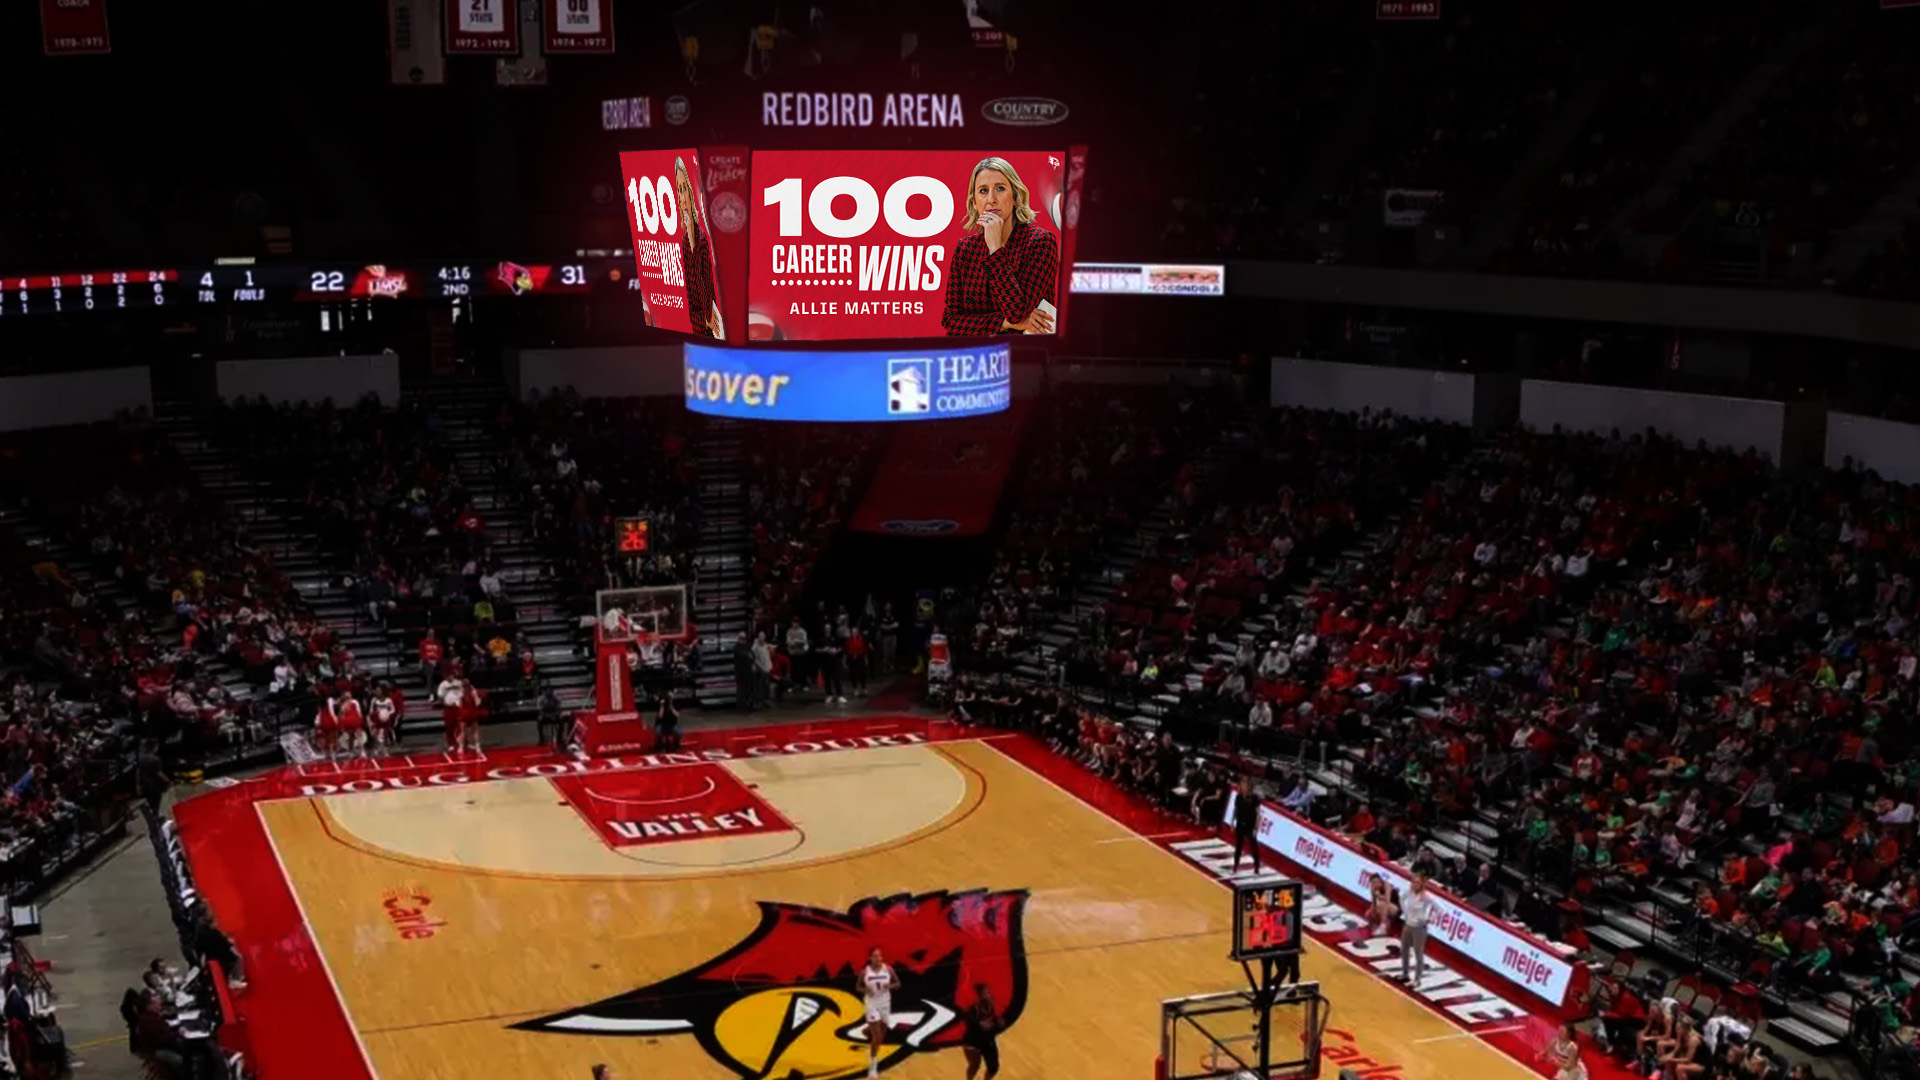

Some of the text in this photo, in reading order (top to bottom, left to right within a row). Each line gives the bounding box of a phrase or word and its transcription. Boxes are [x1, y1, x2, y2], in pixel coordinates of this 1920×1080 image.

[763, 92, 965, 128] REDBIRD ARENA
[993, 102, 1056, 115] COUNTRY
[628, 175, 678, 236] 100
[764, 176, 955, 238] 100
[149, 270, 166, 282] 24
[200, 271, 214, 287] 4
[245, 270, 254, 287] 1
[438, 266, 471, 281] 4:16
[560, 265, 587, 284] 31
[772, 244, 944, 291] CAREER WINS
[311, 271, 345, 292] 22
[442, 284, 469, 295] 2ND
[85, 298, 94, 310] 0
[154, 294, 164, 305] 0
[233, 288, 265, 302] FOULS
[789, 301, 924, 315] ALLIE MATTERS
[302, 732, 927, 795] DOUG COLLINS COURT
[606, 807, 766, 839] VALLEY
[1295, 835, 1334, 868] meijer
[383, 895, 448, 940] Carle
[1428, 905, 1475, 943] meijer
[1501, 945, 1553, 986] meijer
[1337, 936, 1530, 1025] STATE
